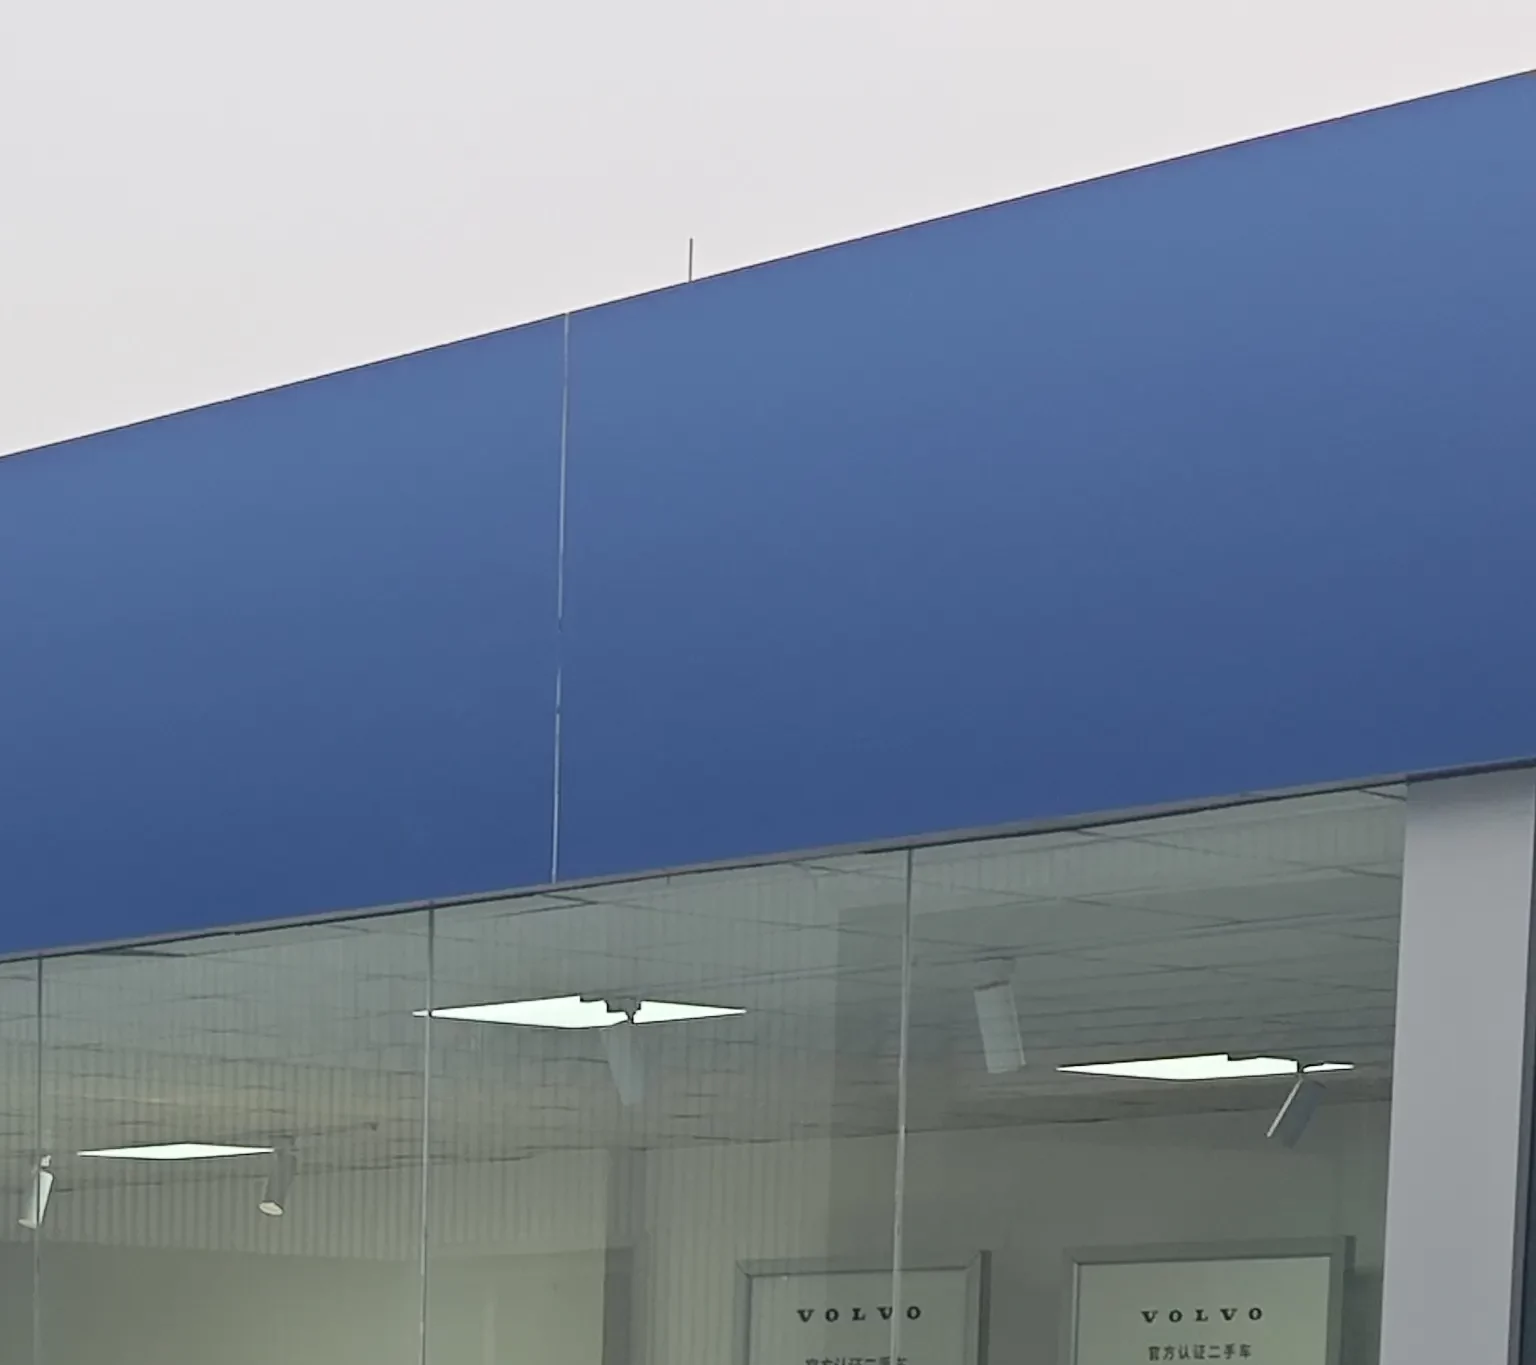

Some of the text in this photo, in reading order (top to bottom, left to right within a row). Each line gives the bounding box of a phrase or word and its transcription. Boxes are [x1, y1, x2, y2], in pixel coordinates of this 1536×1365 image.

[797, 1306, 921, 1322] VOLVO
[1141, 1307, 1263, 1323] VOLVO
[1148, 1343, 1251, 1361] 官方认证二手车
